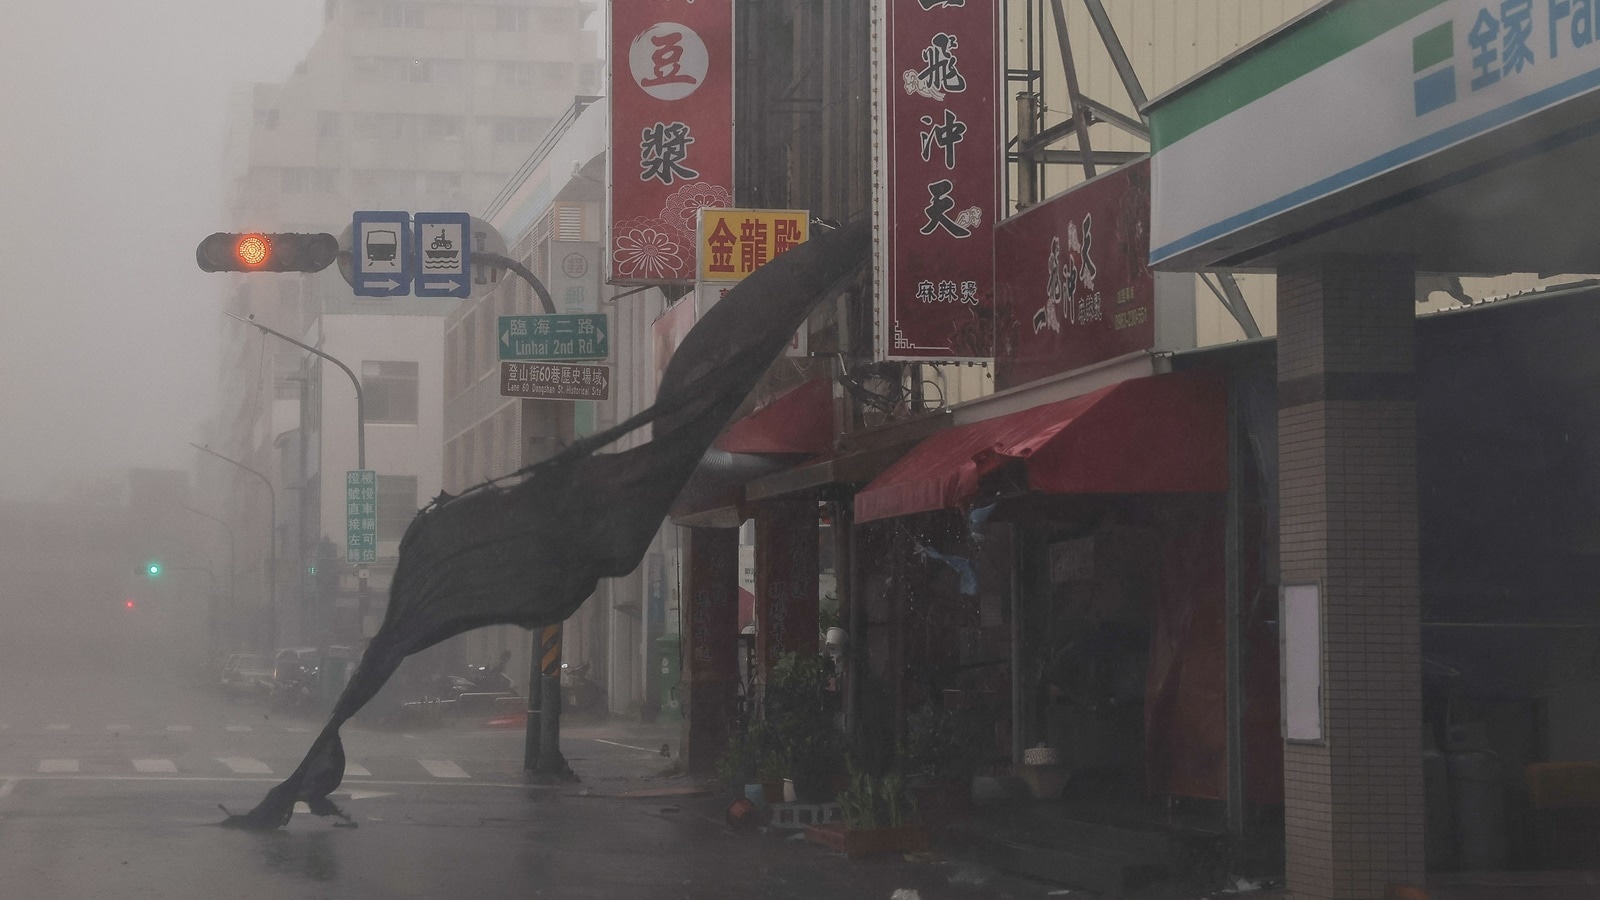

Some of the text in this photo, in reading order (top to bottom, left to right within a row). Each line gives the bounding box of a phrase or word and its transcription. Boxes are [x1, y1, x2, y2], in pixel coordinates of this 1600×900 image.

[1468, 0, 1600, 92] 全家 Fa
[641, 0, 699, 185] 豆漿
[916, 279, 979, 305] 麻辣燙
[510, 319, 594, 336] 臨海二路
[515, 340, 548, 355] Linhai
[553, 339, 574, 354] 2nd
[508, 364, 603, 385] 登山街60巷歷史場域
[507, 382, 520, 392] Lane
[522, 383, 530, 392] 60
[592, 386, 602, 396] Site
[348, 472, 360, 560] 燈號直接左轉
[361, 472, 374, 560] 機慢車輛可依
